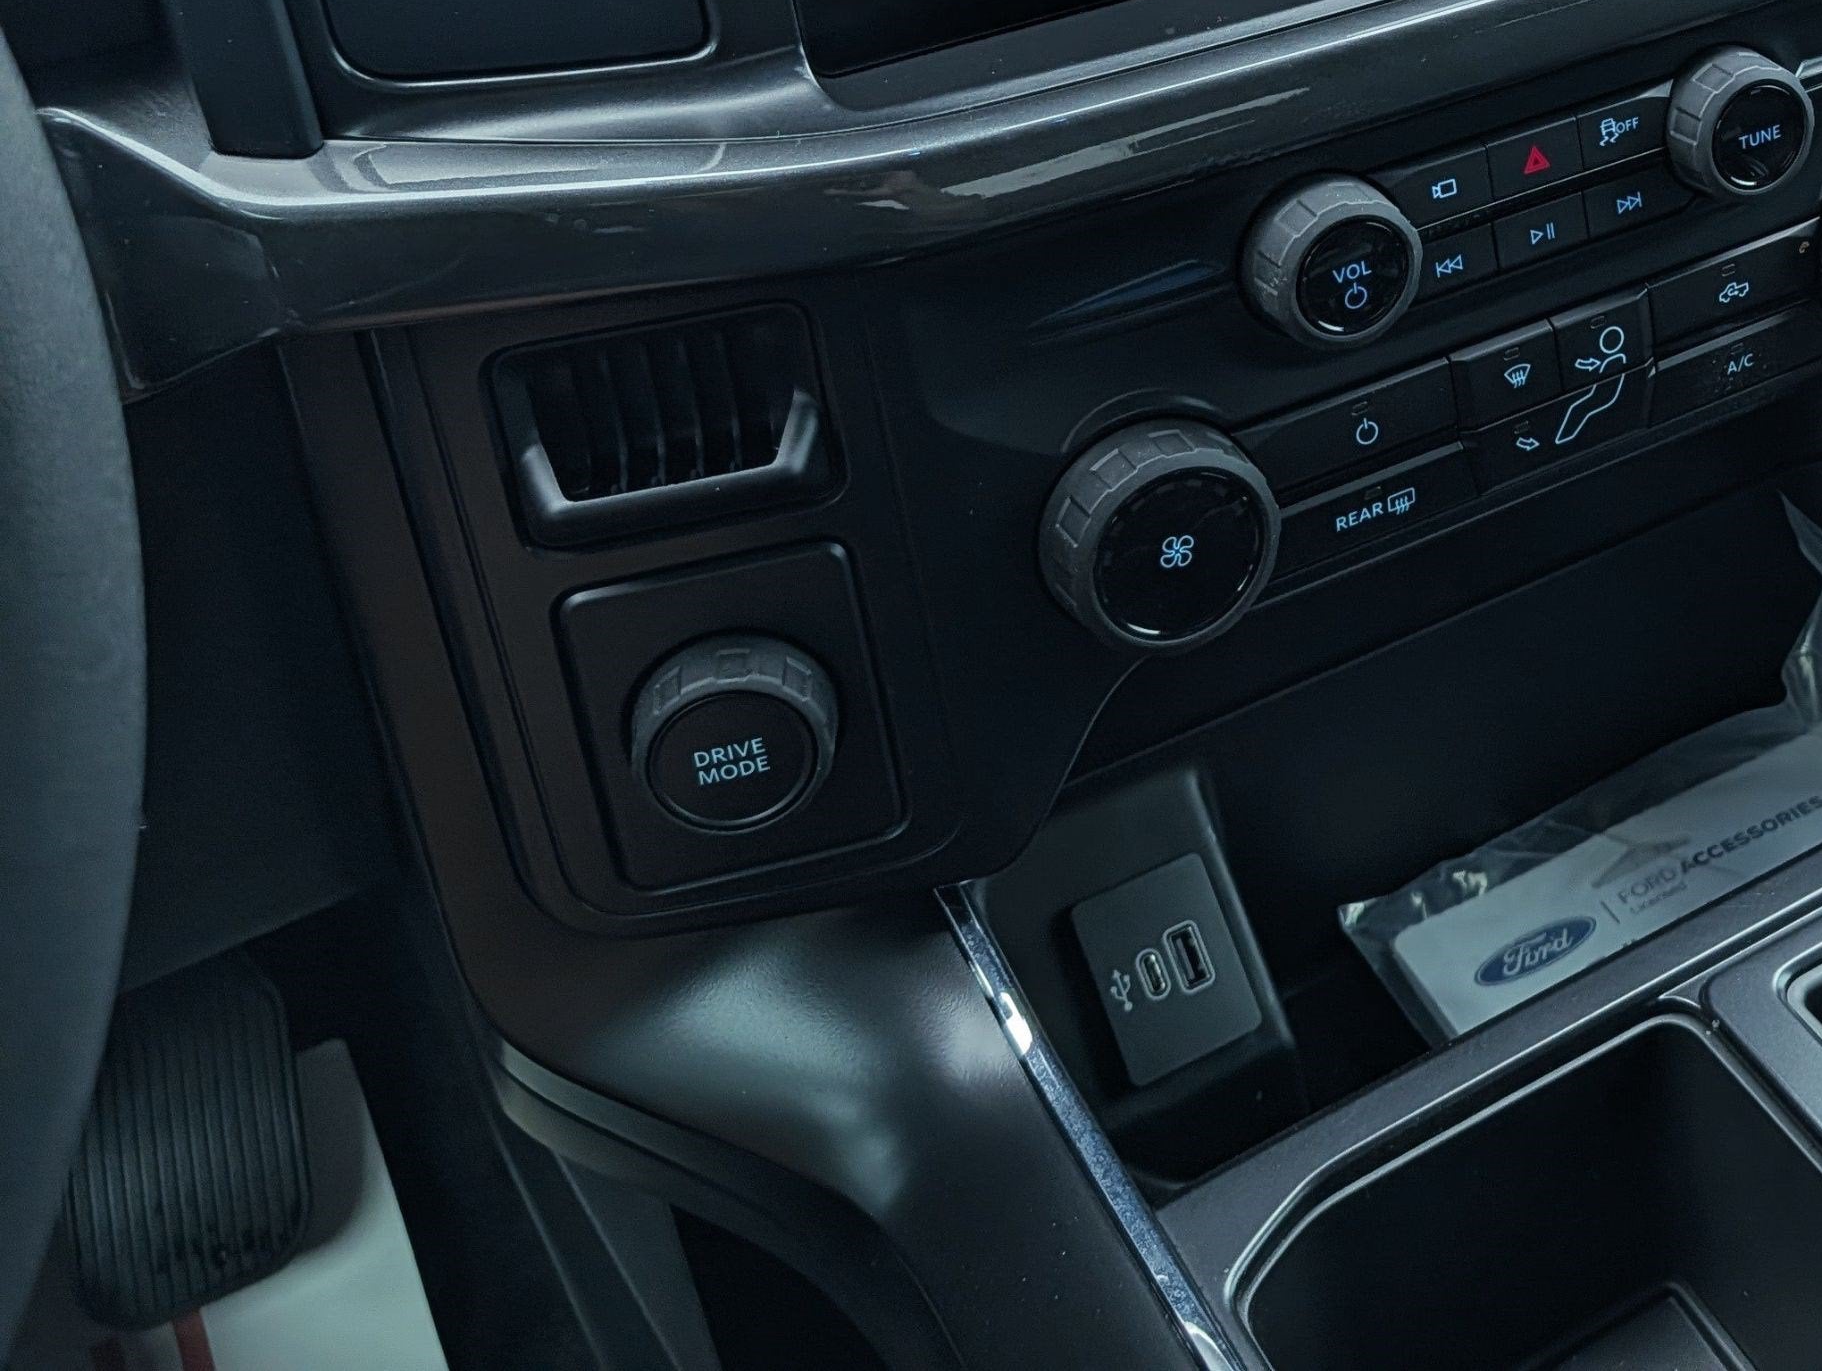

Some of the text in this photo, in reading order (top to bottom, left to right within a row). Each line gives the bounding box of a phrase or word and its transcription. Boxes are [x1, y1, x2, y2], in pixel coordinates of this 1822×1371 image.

[1615, 116, 1640, 135] OFF
[1737, 124, 1783, 150] TUNE
[1332, 259, 1373, 284] VOL
[1726, 353, 1755, 375] A/C
[1335, 501, 1384, 533] REAR
[692, 736, 767, 769] DRIVE
[697, 755, 771, 786] MODE
[1616, 863, 1680, 904] FORD
[1501, 926, 1574, 977] Ford
